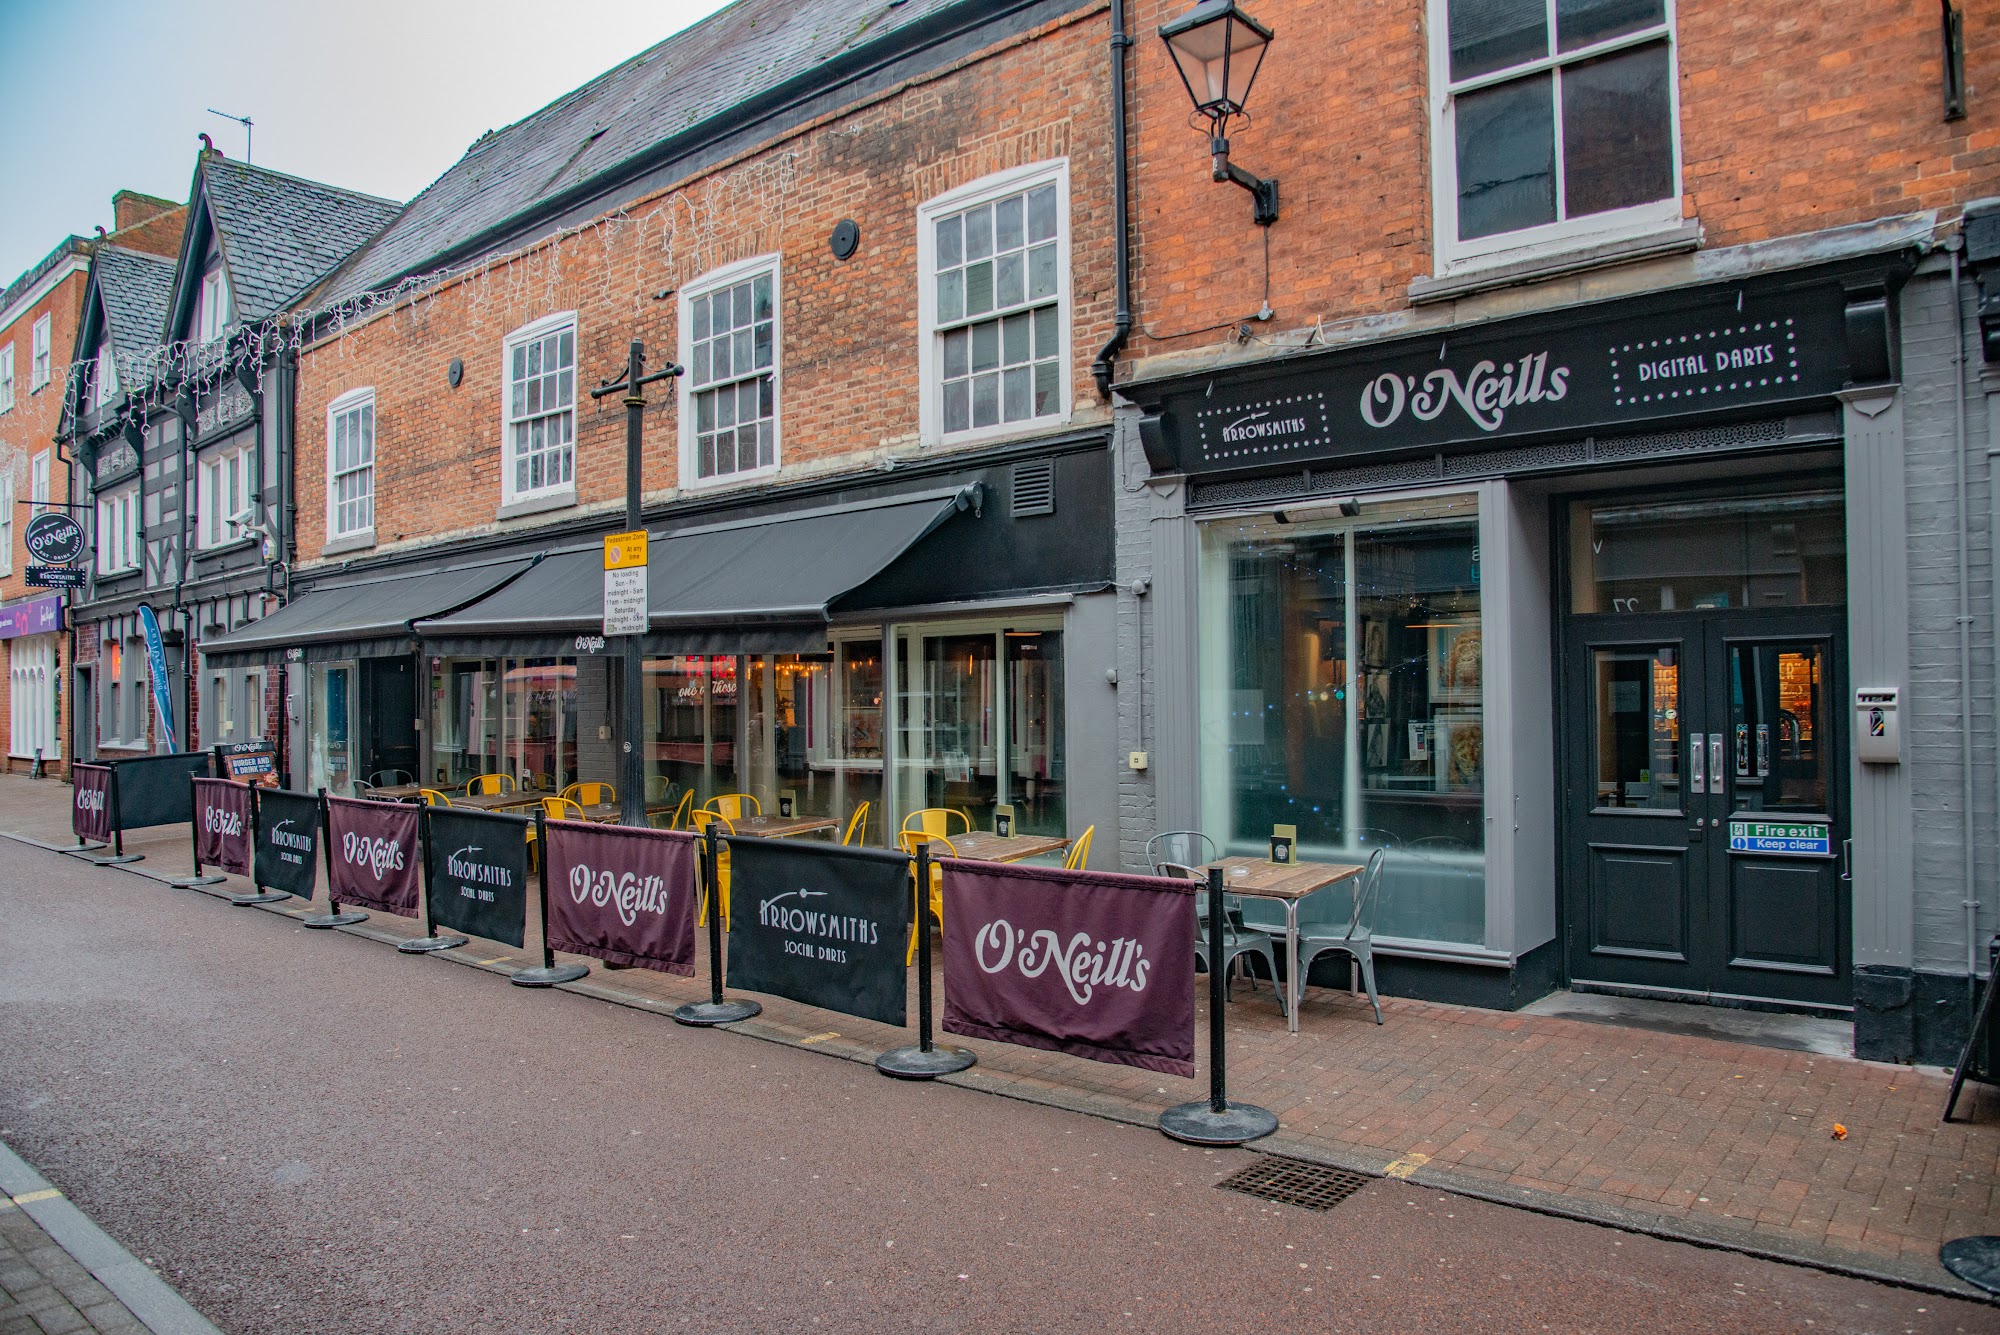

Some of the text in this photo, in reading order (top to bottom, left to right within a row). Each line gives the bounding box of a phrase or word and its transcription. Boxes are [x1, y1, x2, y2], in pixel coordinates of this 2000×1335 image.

[1638, 343, 1774, 383] DIGITAL DARTS
[1222, 414, 1306, 441] ARROWSMITHS
[606, 533, 645, 544] Pedestrian Zone
[633, 545, 642, 553] any
[620, 570, 639, 578] loading
[607, 589, 629, 598] midnight
[623, 596, 645, 605] midnight
[614, 606, 636, 615] Saturday
[607, 615, 629, 624] midnight
[622, 624, 644, 633] midnight
[678, 686, 698, 698] one
[232, 756, 270, 767] BURGER AND
[240, 765, 259, 774] DRINK
[1755, 825, 1819, 838] Fire exit
[272, 826, 312, 852] ARROWSMITHS
[1756, 838, 1818, 851] Keep clear
[280, 851, 303, 865] SOCIAL DARTS
[343, 831, 404, 881] O'Neill's
[447, 853, 512, 887] ARROWSMITHS
[461, 885, 495, 903] SOCIAL DARTS
[569, 864, 668, 927] O'Neill's
[759, 896, 879, 945] ARROWSMITHS
[784, 939, 847, 965] SOCIAL DARTS
[974, 919, 1151, 1007] O'Neill's
